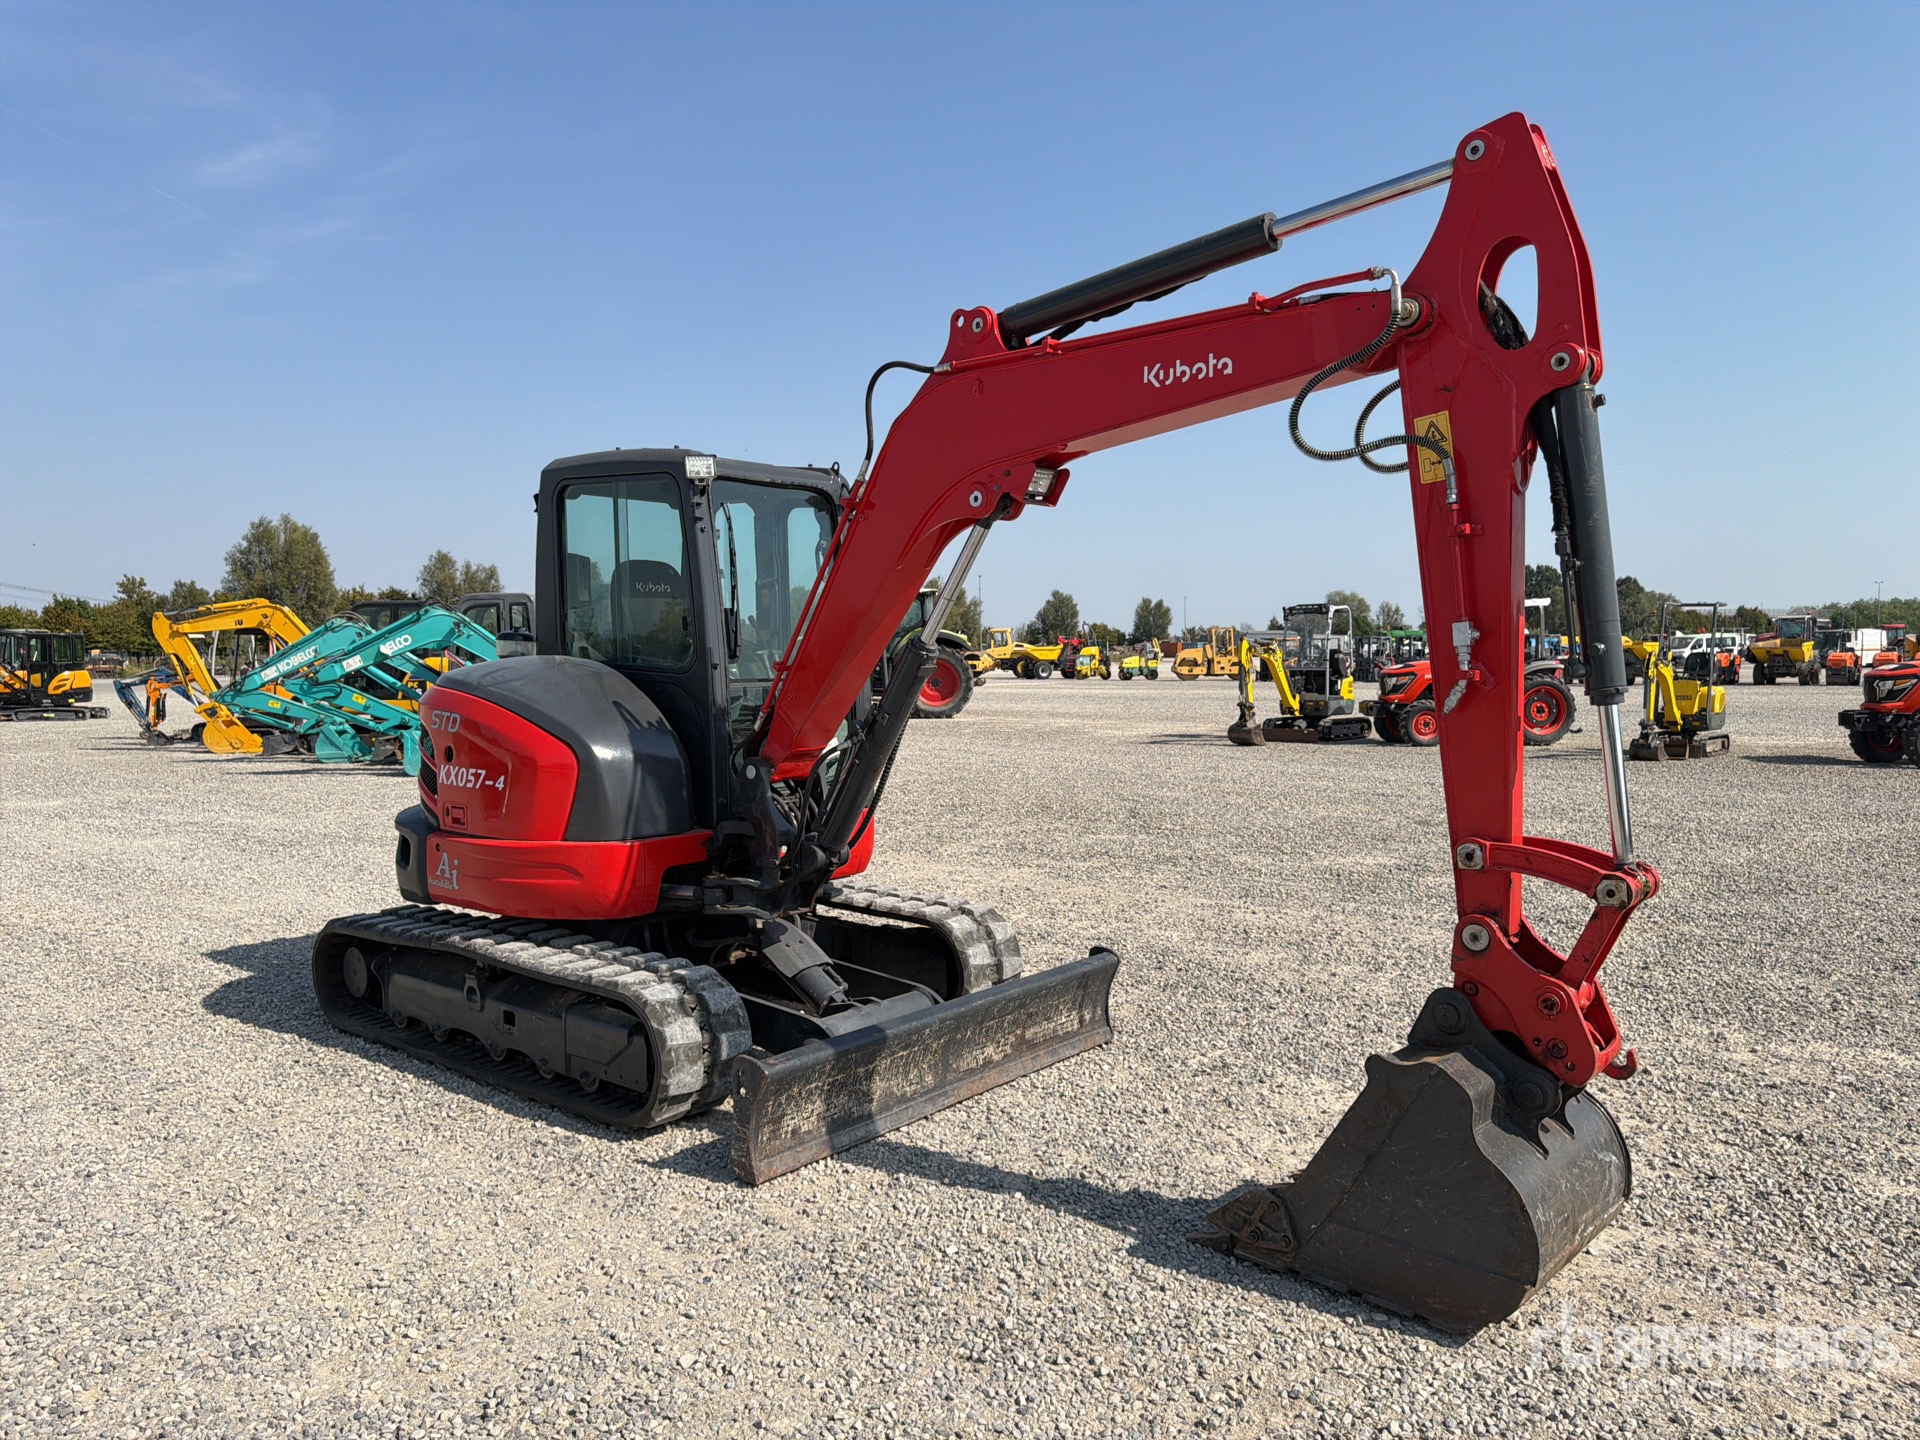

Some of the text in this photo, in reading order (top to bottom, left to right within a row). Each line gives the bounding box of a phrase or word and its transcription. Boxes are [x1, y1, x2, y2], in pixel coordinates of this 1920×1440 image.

[1143, 353, 1233, 388] Kubota
[635, 582, 671, 592] Kubota
[380, 634, 412, 654] ELCO
[430, 709, 461, 733] STD
[438, 764, 505, 791] KX057-4
